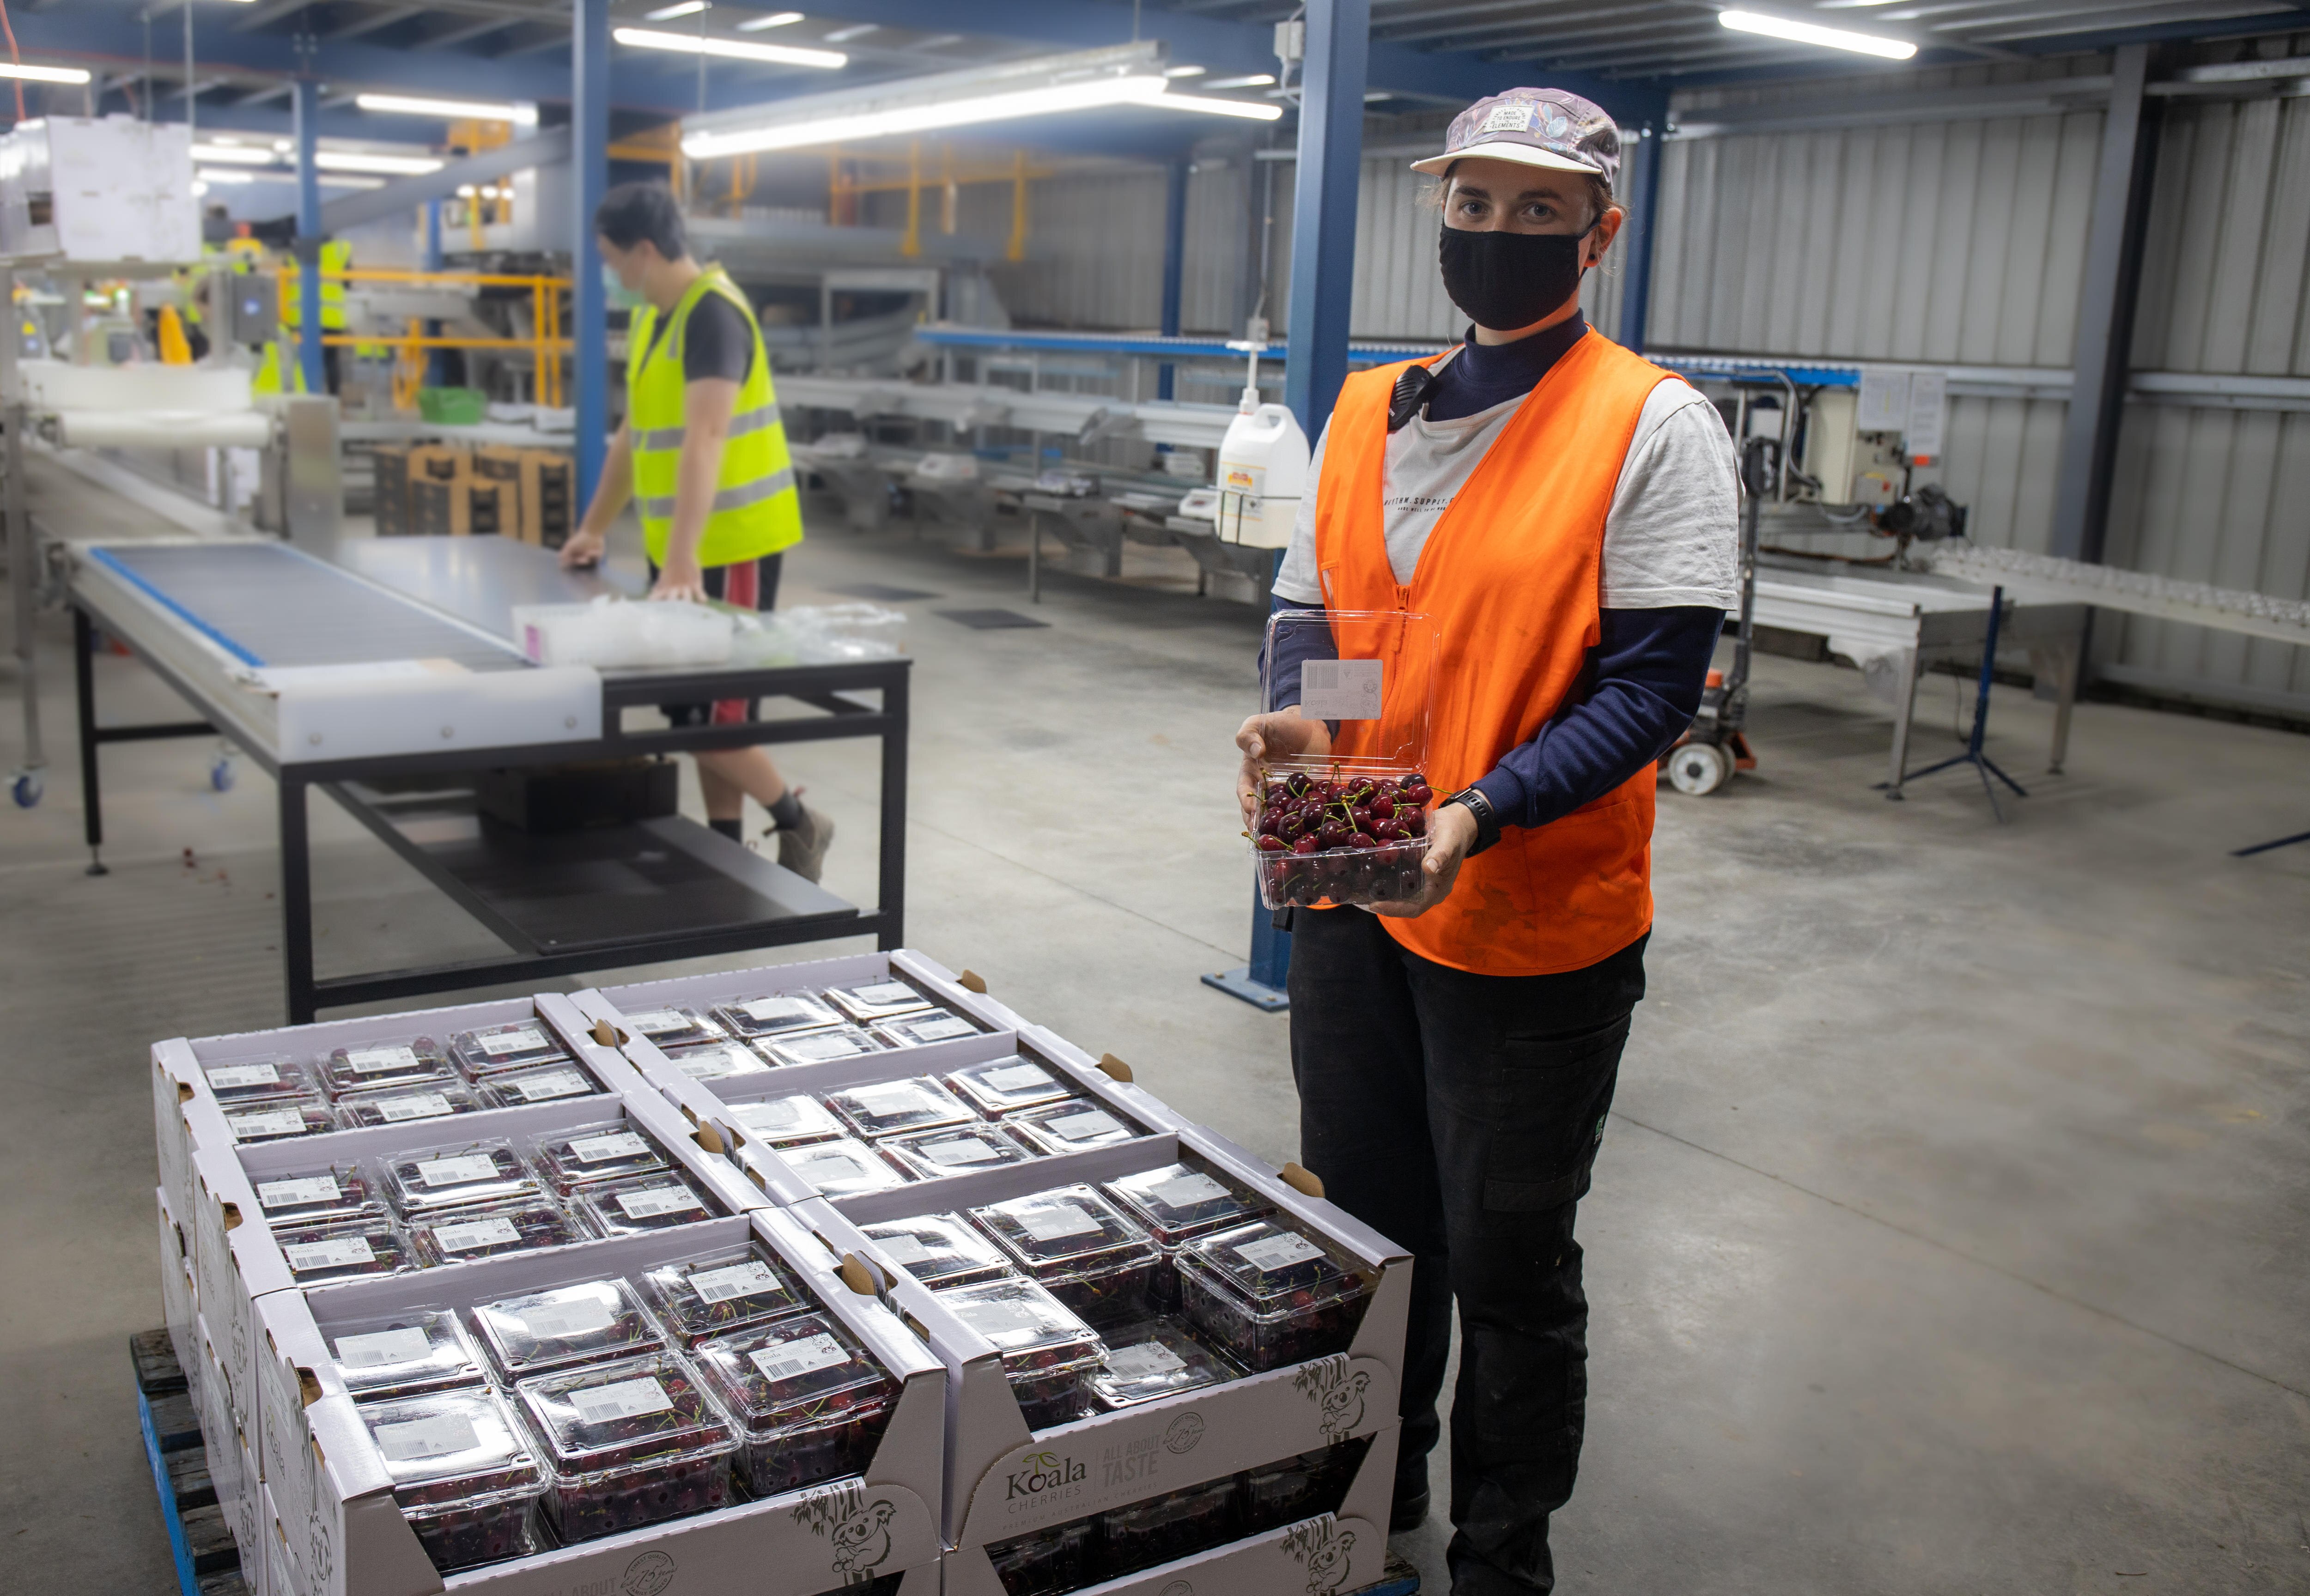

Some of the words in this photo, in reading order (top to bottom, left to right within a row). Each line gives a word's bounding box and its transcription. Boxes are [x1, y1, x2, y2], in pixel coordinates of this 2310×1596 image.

[695, 1276, 718, 1285] Koala
[757, 1353, 781, 1361] Koala
[1103, 1444, 1122, 1461] ALL
[1126, 1434, 1161, 1457] ABOUT
[1005, 1456, 1087, 1500] Koala
[1102, 1450, 1160, 1487] TASTE
[1003, 1514, 1045, 1529] PREMIUM
[1052, 1496, 1109, 1517] AUSTRALIAN
[1114, 1482, 1158, 1499] CHERRIES
[1008, 1485, 1082, 1514] CHERRIES
[630, 1556, 647, 1572] FINEST
[648, 1554, 669, 1563] QUALITY
[630, 1586, 648, 1596] FAMILY
[649, 1578, 668, 1594] OWNED
